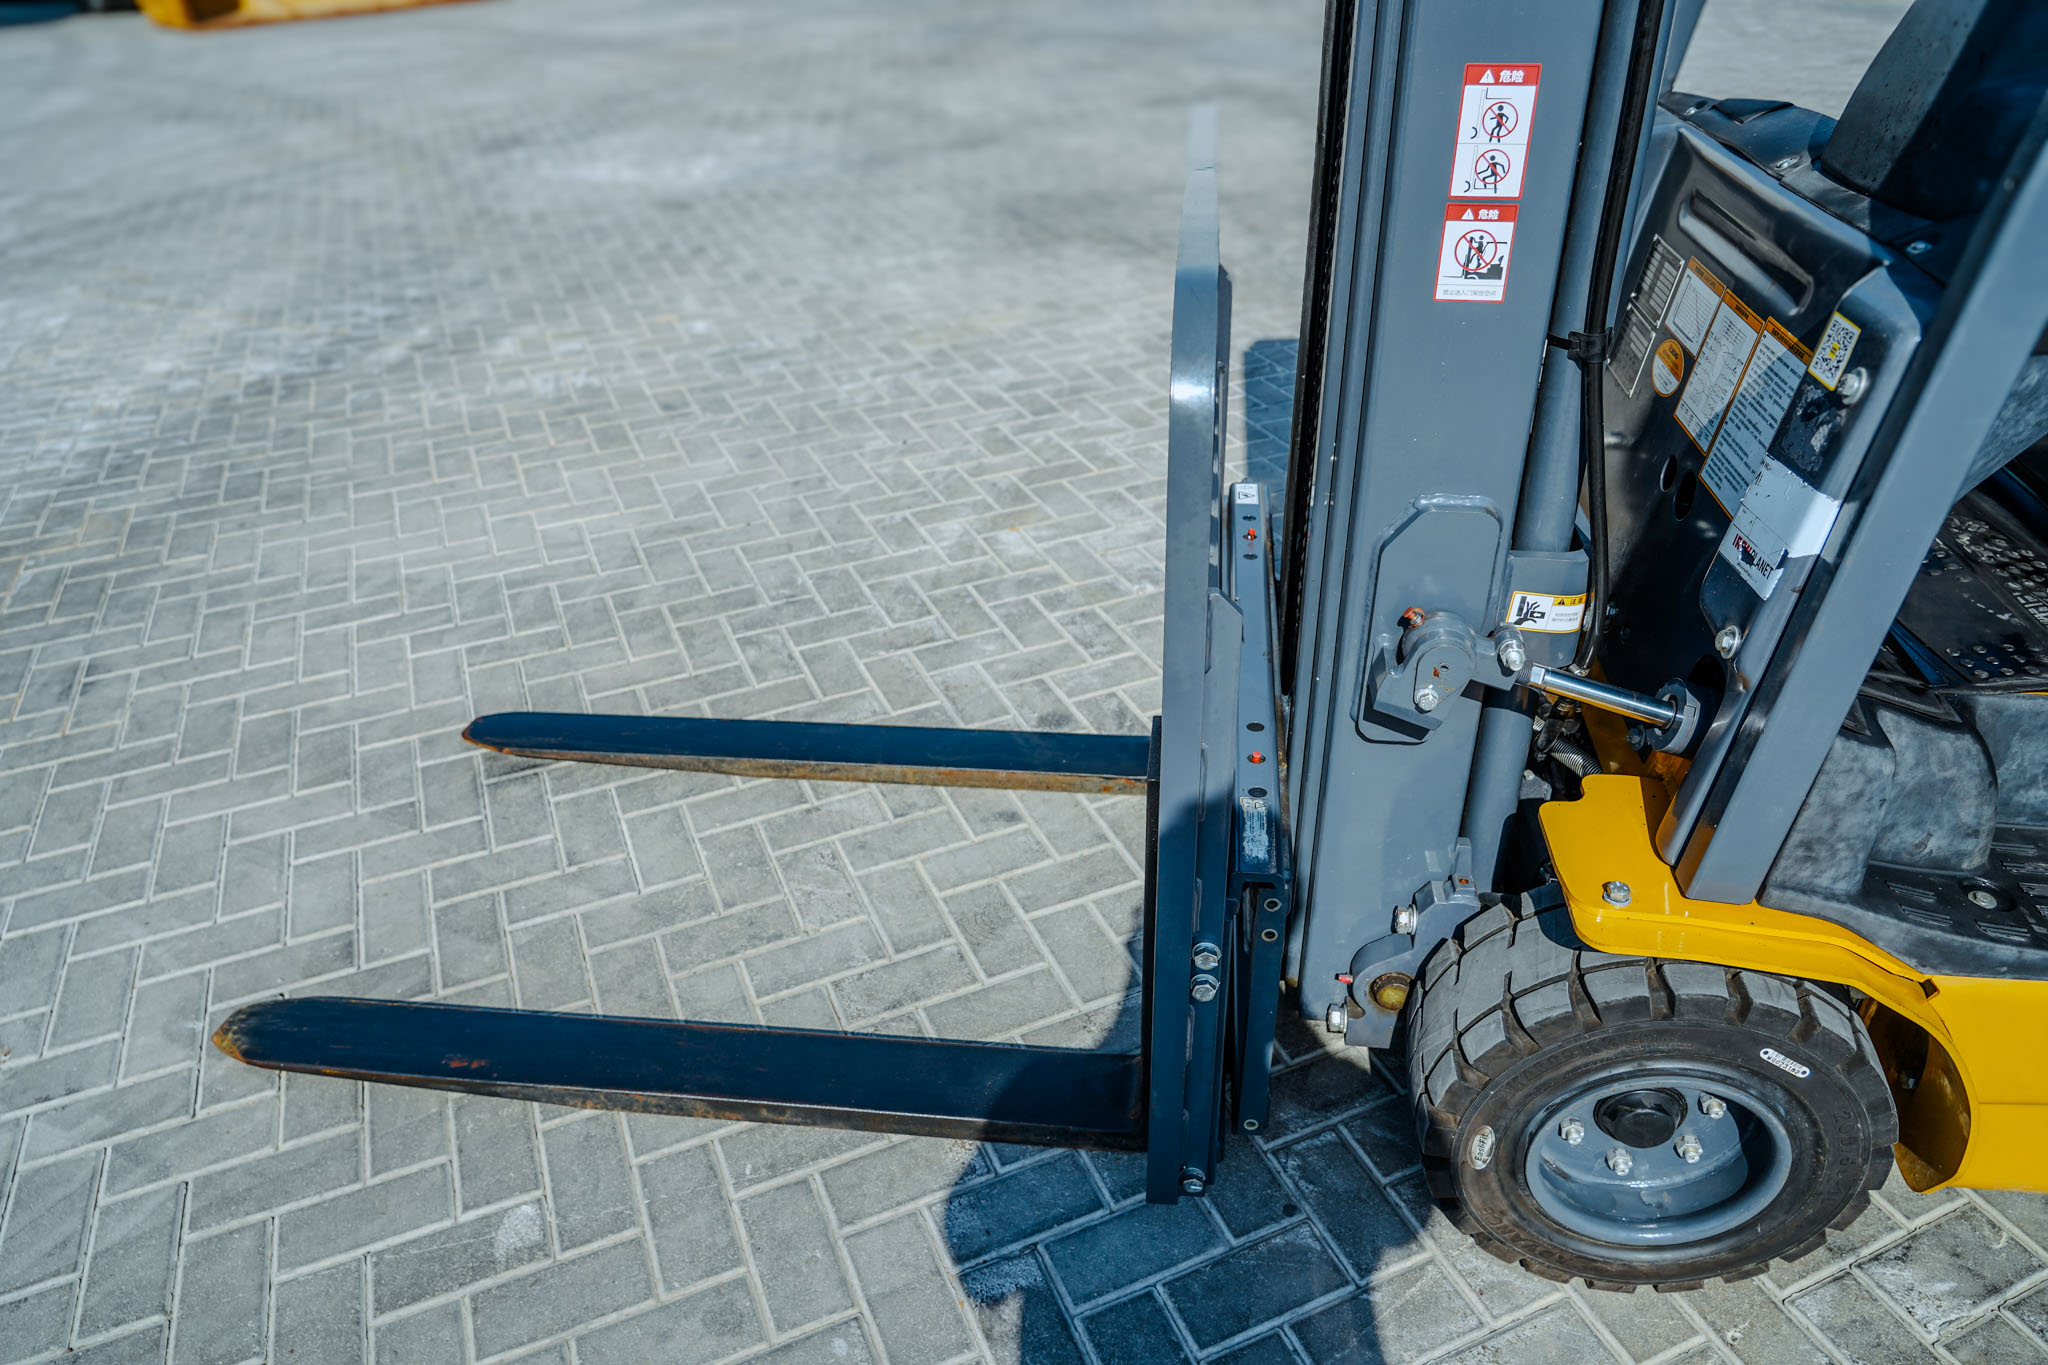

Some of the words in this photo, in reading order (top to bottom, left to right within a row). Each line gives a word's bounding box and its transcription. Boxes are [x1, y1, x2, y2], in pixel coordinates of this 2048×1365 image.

[1499, 69, 1525, 83] 危险
[1478, 209, 1499, 220] 危险
[1474, 1133, 1489, 1162] Easi-Fit
